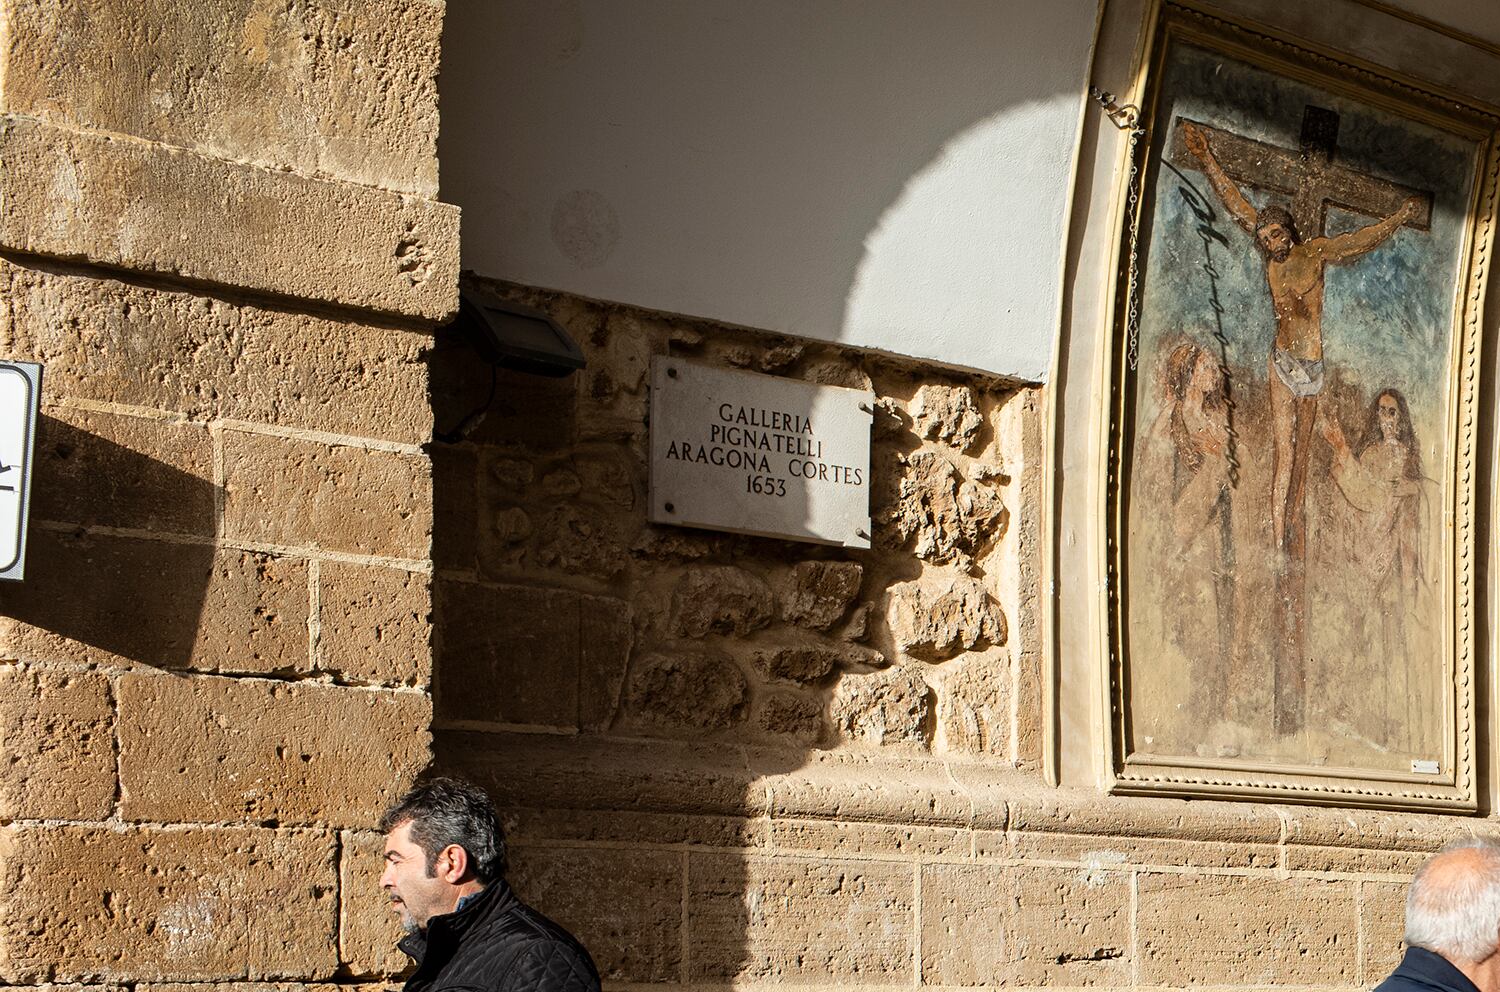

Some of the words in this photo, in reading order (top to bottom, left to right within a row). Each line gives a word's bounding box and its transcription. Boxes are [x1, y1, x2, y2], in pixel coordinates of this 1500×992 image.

[719, 403, 814, 435] GALLERIA
[710, 424, 822, 458] PIGNATELLI
[666, 440, 771, 473] ARAGONA
[788, 459, 863, 486] CORTES
[746, 474, 787, 497] 1653
